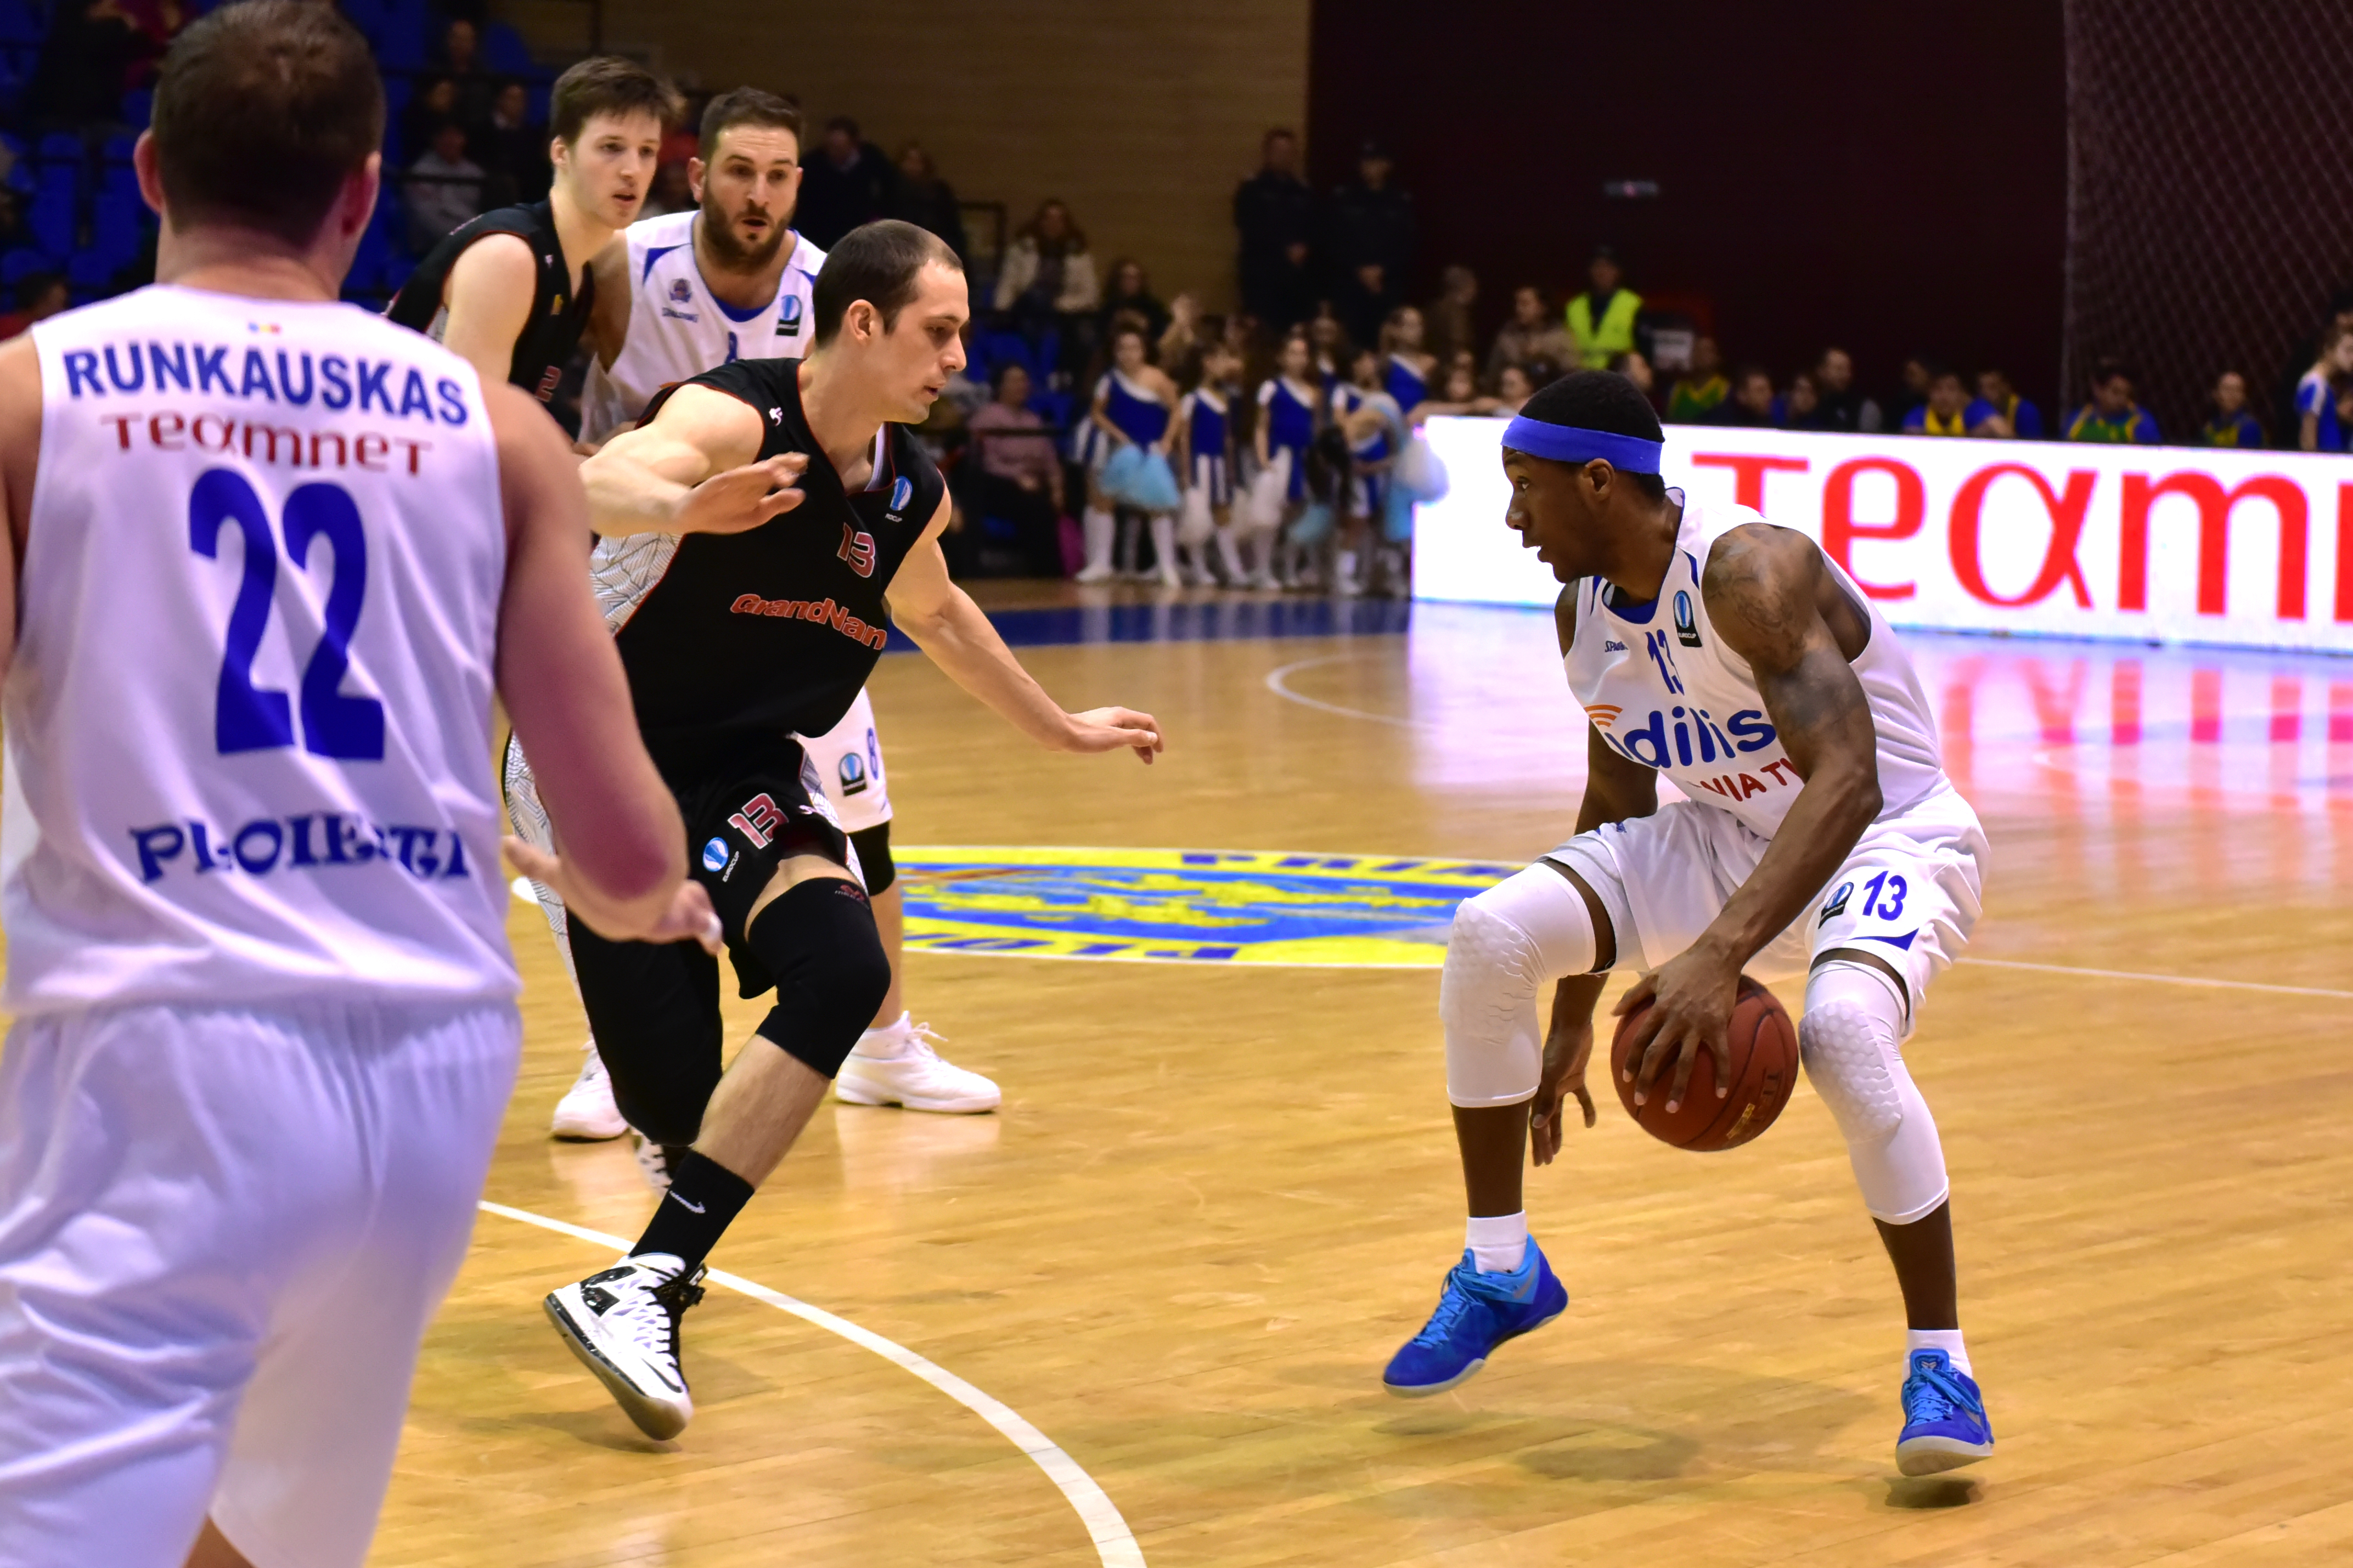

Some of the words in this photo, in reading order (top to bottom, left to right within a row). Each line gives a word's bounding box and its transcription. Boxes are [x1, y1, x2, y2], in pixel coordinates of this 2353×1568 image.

[63, 340, 470, 427] RUNKAUSKAS
[837, 522, 876, 578] 13
[1691, 453, 2353, 622] Team
[189, 466, 385, 761] 22
[1645, 629, 1685, 696] 13
[727, 793, 789, 850] 13
[722, 850, 740, 882] EUROCUP
[1862, 870, 1907, 921] 13
